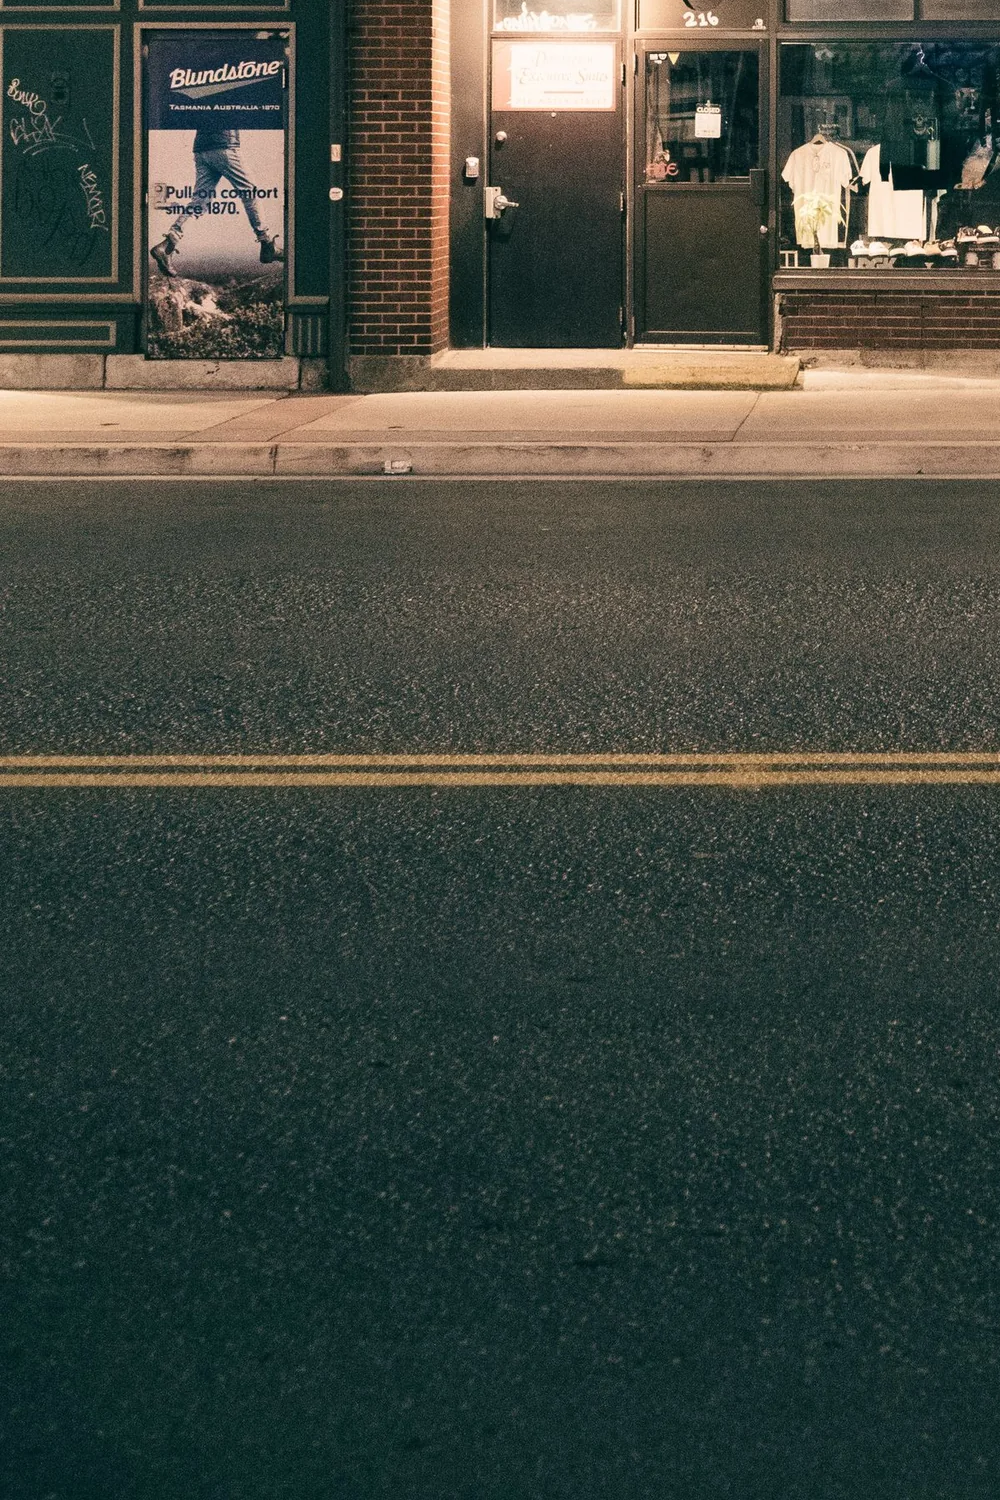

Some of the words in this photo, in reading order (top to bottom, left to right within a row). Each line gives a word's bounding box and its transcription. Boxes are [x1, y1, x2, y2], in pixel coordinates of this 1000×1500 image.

[683, 11, 719, 27] 216
[169, 61, 280, 89] Blundstone
[167, 186, 217, 199] Pull-on
[221, 186, 278, 199] comfort
[166, 202, 203, 215] since
[206, 202, 240, 214] 1870.
